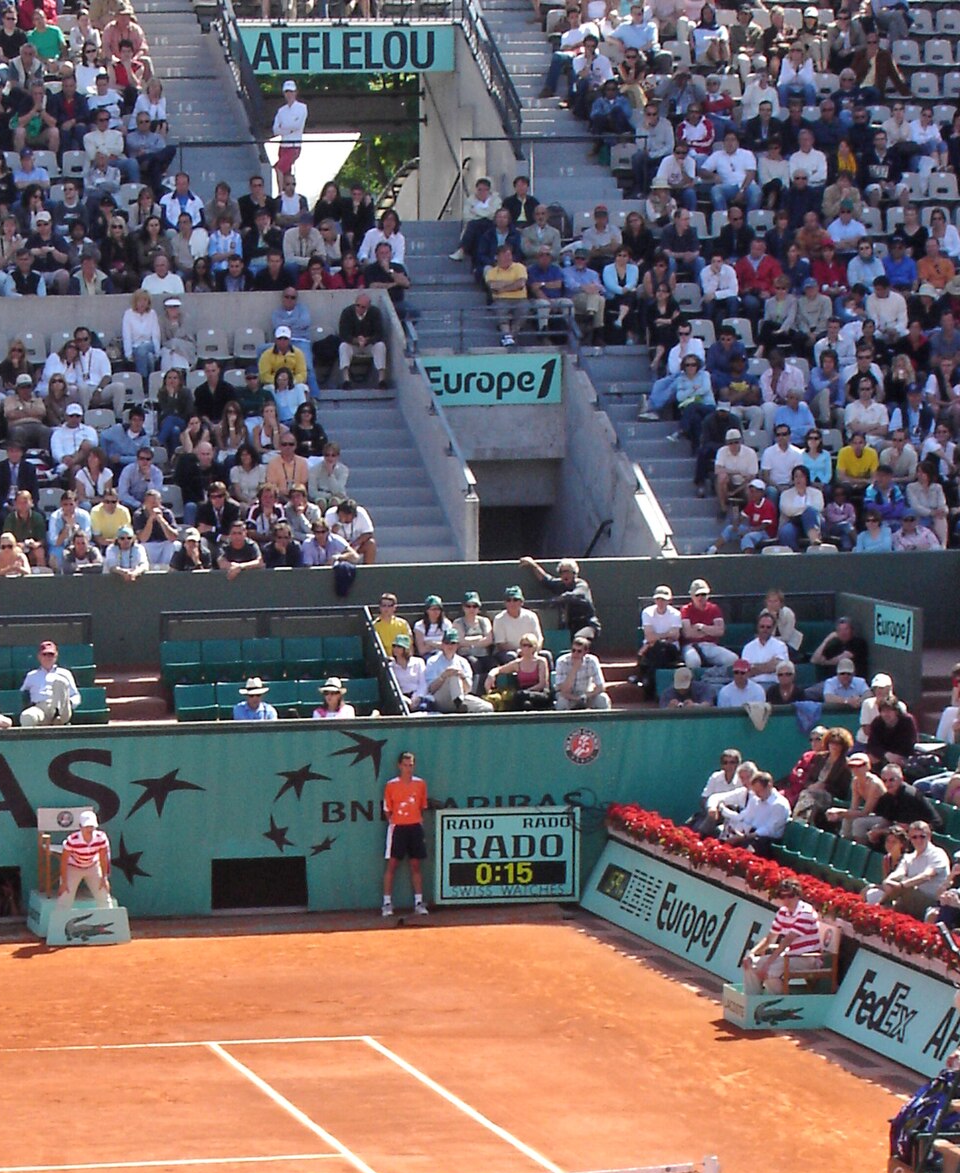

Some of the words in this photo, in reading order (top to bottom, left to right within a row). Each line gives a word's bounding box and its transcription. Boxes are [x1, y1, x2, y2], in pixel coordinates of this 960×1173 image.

[251, 31, 434, 70] AFFLELOU
[322, 800, 386, 823] BN
[427, 791, 581, 810] ARIBAS
[446, 818, 494, 830] RADO
[522, 816, 571, 829] RADO
[452, 834, 564, 860] RADO
[475, 862, 533, 885] 0:15
[451, 886, 494, 897] SWISS
[502, 884, 565, 896] WATCHES
[620, 869, 663, 922] IBM
[845, 969, 918, 1044] FedEx
